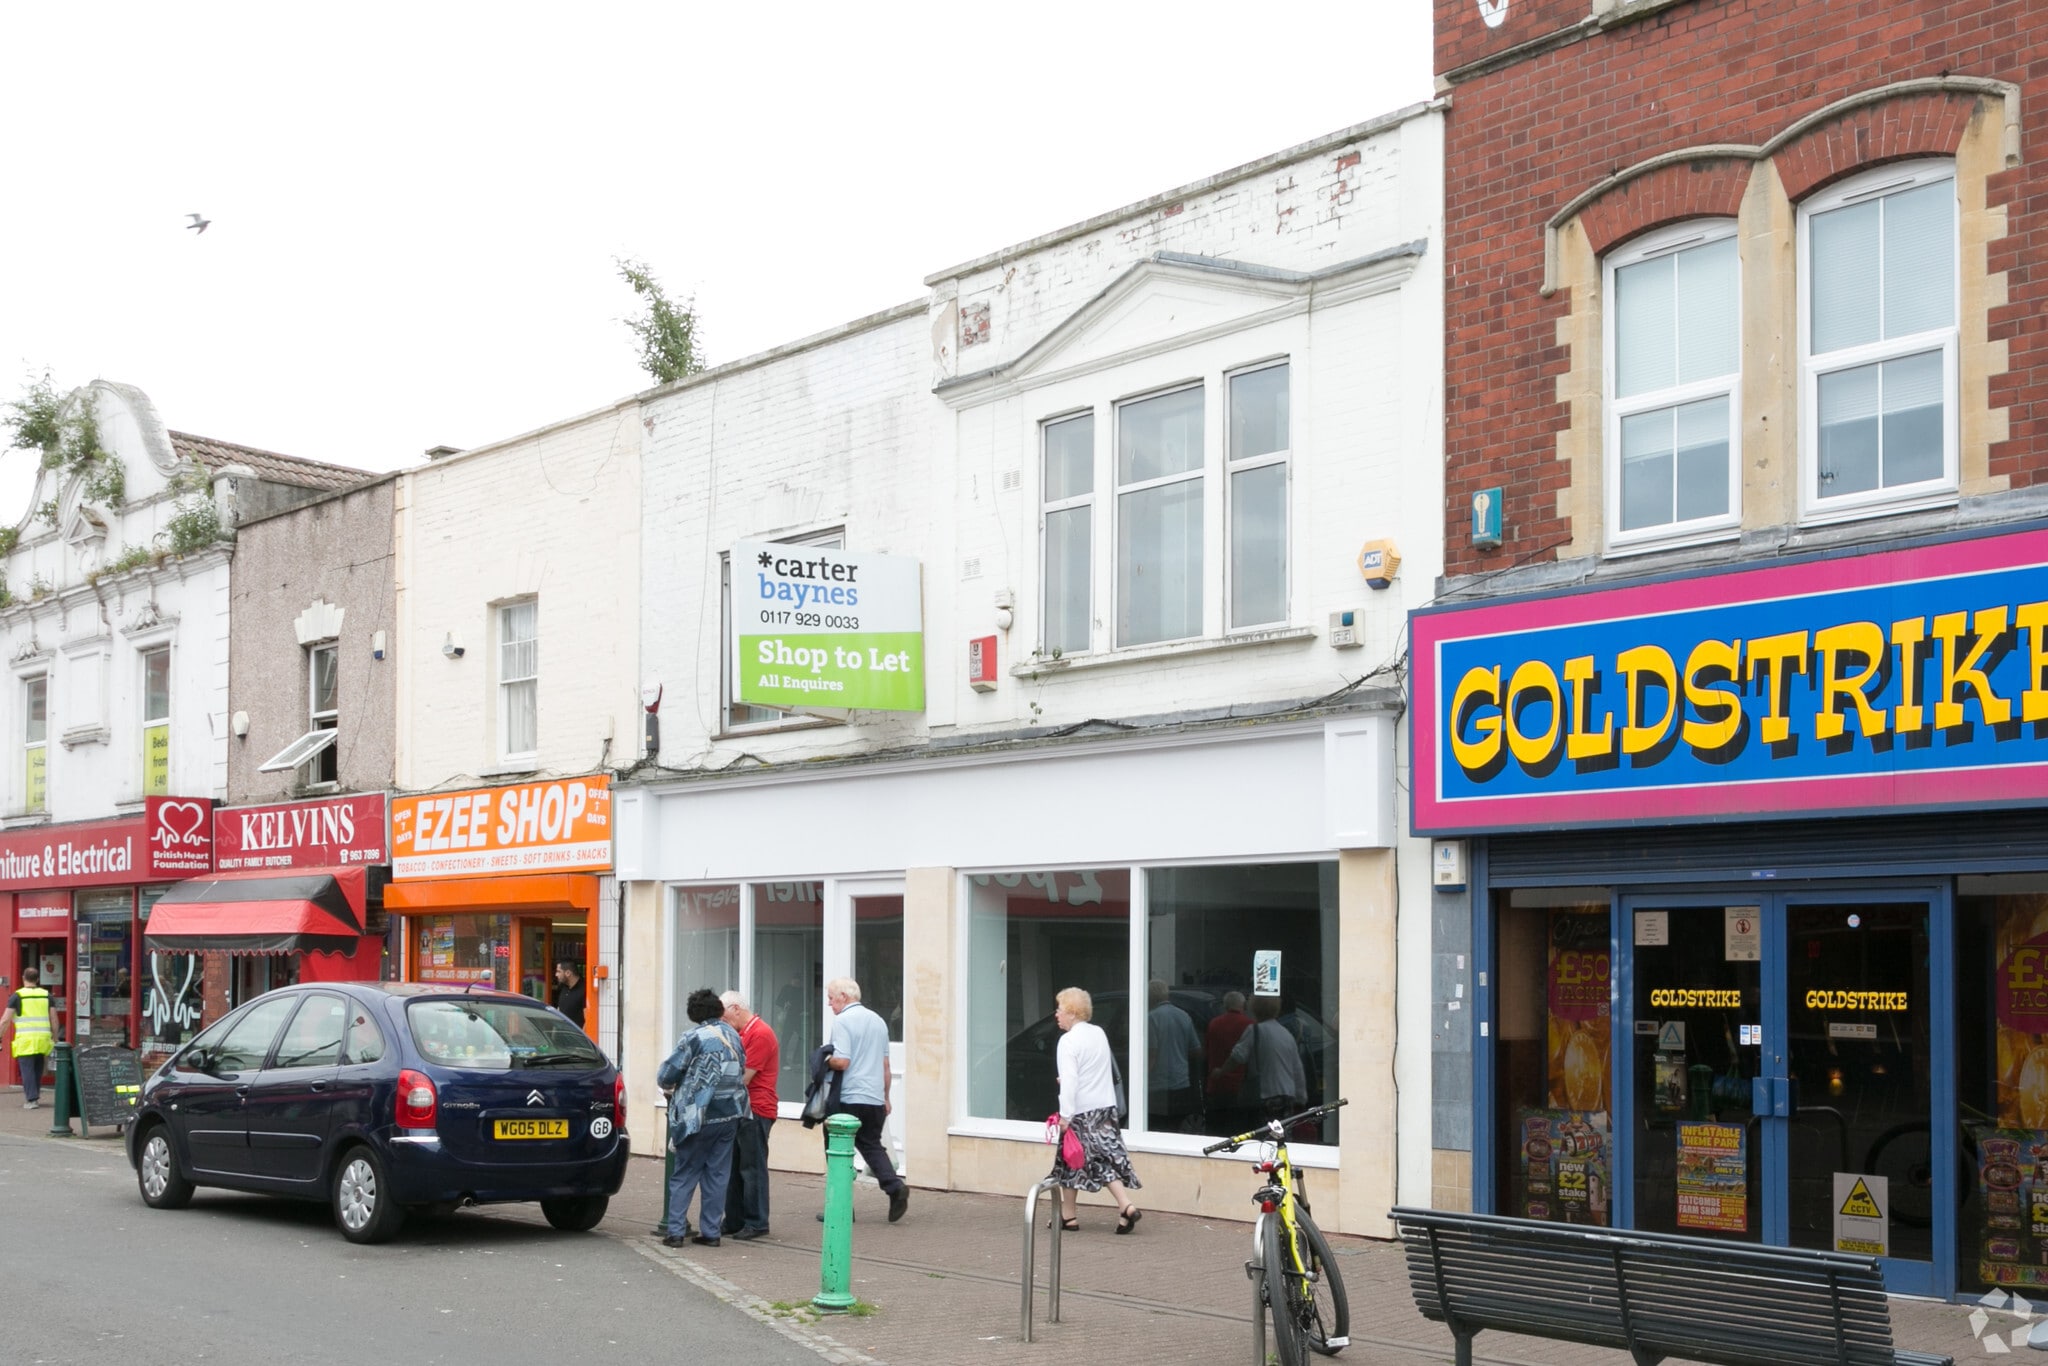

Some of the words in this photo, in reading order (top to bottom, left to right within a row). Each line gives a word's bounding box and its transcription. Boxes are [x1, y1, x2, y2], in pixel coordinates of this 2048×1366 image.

[1364, 553, 1381, 566] ADT
[758, 573, 858, 609] baynes
[760, 610, 791, 624] 0117
[795, 612, 821, 627] 929
[825, 615, 859, 629] 0033
[758, 640, 828, 673] Shop
[834, 646, 862, 670] to
[869, 647, 910, 673] Let
[758, 674, 779, 688] All
[782, 676, 844, 692] Enquires
[152, 736, 168, 749] Beds
[152, 755, 168, 768] from
[588, 788, 609, 800] OPEN
[394, 809, 412, 822] OPEN
[414, 793, 491, 852] EZEE
[496, 782, 587, 846] SHOP
[587, 813, 607, 825] DAYS
[240, 803, 355, 851] KELVINS
[400, 822, 406, 831] 7
[396, 831, 413, 844] DAYS
[42, 845, 56, 878] &
[58, 836, 132, 876] Electrical
[153, 851, 182, 860] British
[183, 852, 209, 861] Heart
[219, 858, 242, 869] QUALITY
[244, 856, 263, 868] FAMILY
[265, 855, 293, 867] BUTCHER
[349, 850, 363, 861] 963
[397, 861, 426, 873] TOBACCO
[431, 857, 485, 872] CONFECTIONERY
[491, 856, 518, 867] SWEETS
[523, 853, 542, 865] SOFT
[543, 851, 571, 863] DRINKS
[576, 848, 607, 860] SNACKS
[153, 860, 209, 870] Foundation
[1650, 988, 1741, 1007] GOLDSTRIKE
[1806, 990, 1908, 1010] GOLDSTRIKE
[501, 1121, 535, 1135] WG05
[538, 1121, 562, 1135] DLZ
[593, 1121, 609, 1135] GB
[1681, 1125, 1741, 1138] INFLATABLE
[1681, 1136, 1712, 1146] THEME
[1713, 1137, 1740, 1148] PARK
[1559, 1162, 1585, 1172] new
[1558, 1171, 1587, 1188] £2
[1558, 1188, 1587, 1198] stake
[1679, 1205, 1699, 1214] FARM
[1700, 1206, 1721, 1216] SHOP
[1850, 1204, 1871, 1214] CCTV
